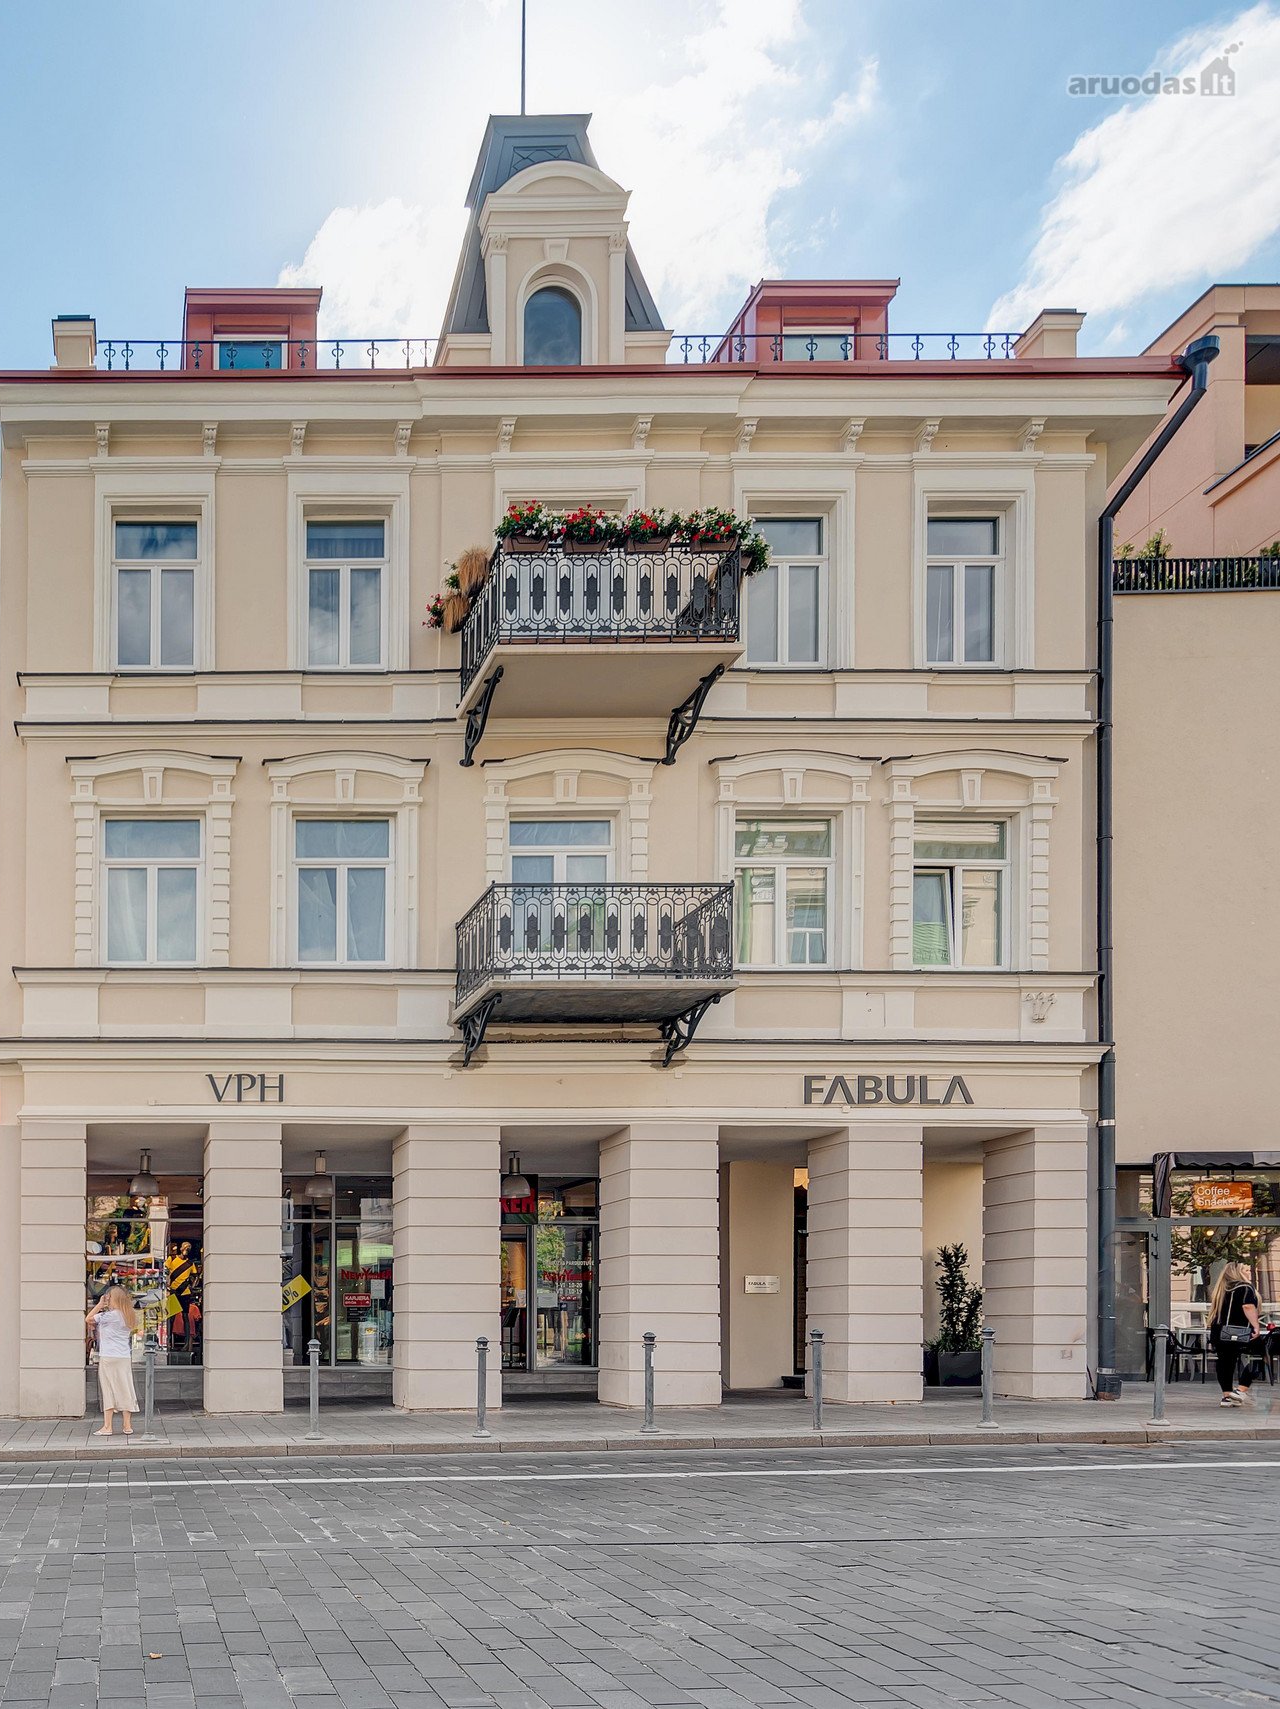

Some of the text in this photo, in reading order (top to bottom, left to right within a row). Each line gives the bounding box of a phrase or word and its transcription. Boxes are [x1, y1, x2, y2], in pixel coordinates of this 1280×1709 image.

[205, 1074, 284, 1102] VPH
[804, 1075, 975, 1105] FABULA
[1196, 1186, 1231, 1196] Coffee
